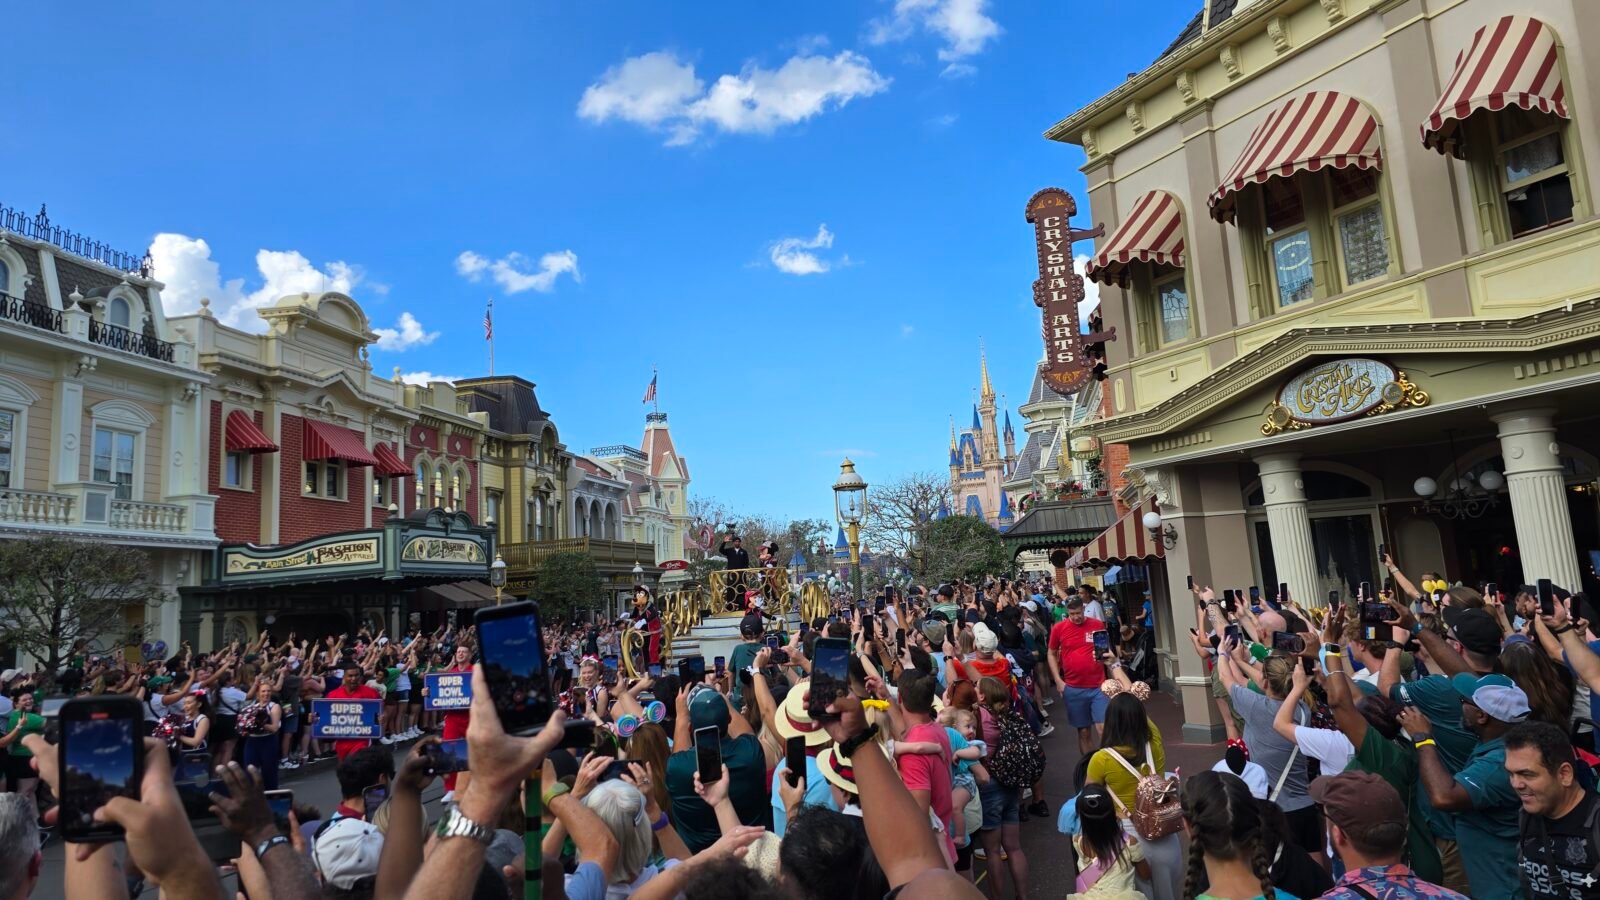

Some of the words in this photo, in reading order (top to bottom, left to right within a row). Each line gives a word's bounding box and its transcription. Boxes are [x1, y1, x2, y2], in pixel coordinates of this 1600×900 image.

[1043, 216, 1068, 302] CRYSTAL
[1052, 314, 1074, 364] ARTS
[1297, 363, 1353, 414] CRYSTAL
[1321, 370, 1376, 417] ARTS
[285, 554, 307, 566] Street
[316, 542, 373, 564] FASHION
[505, 580, 526, 590] OUSE
[438, 676, 463, 687] SUPER
[438, 687, 464, 697] BOWL
[432, 697, 470, 706] CHAMPIONS
[330, 703, 363, 714] SUPER
[330, 715, 363, 725] BOWL
[321, 726, 372, 735] CHAMPIONS
